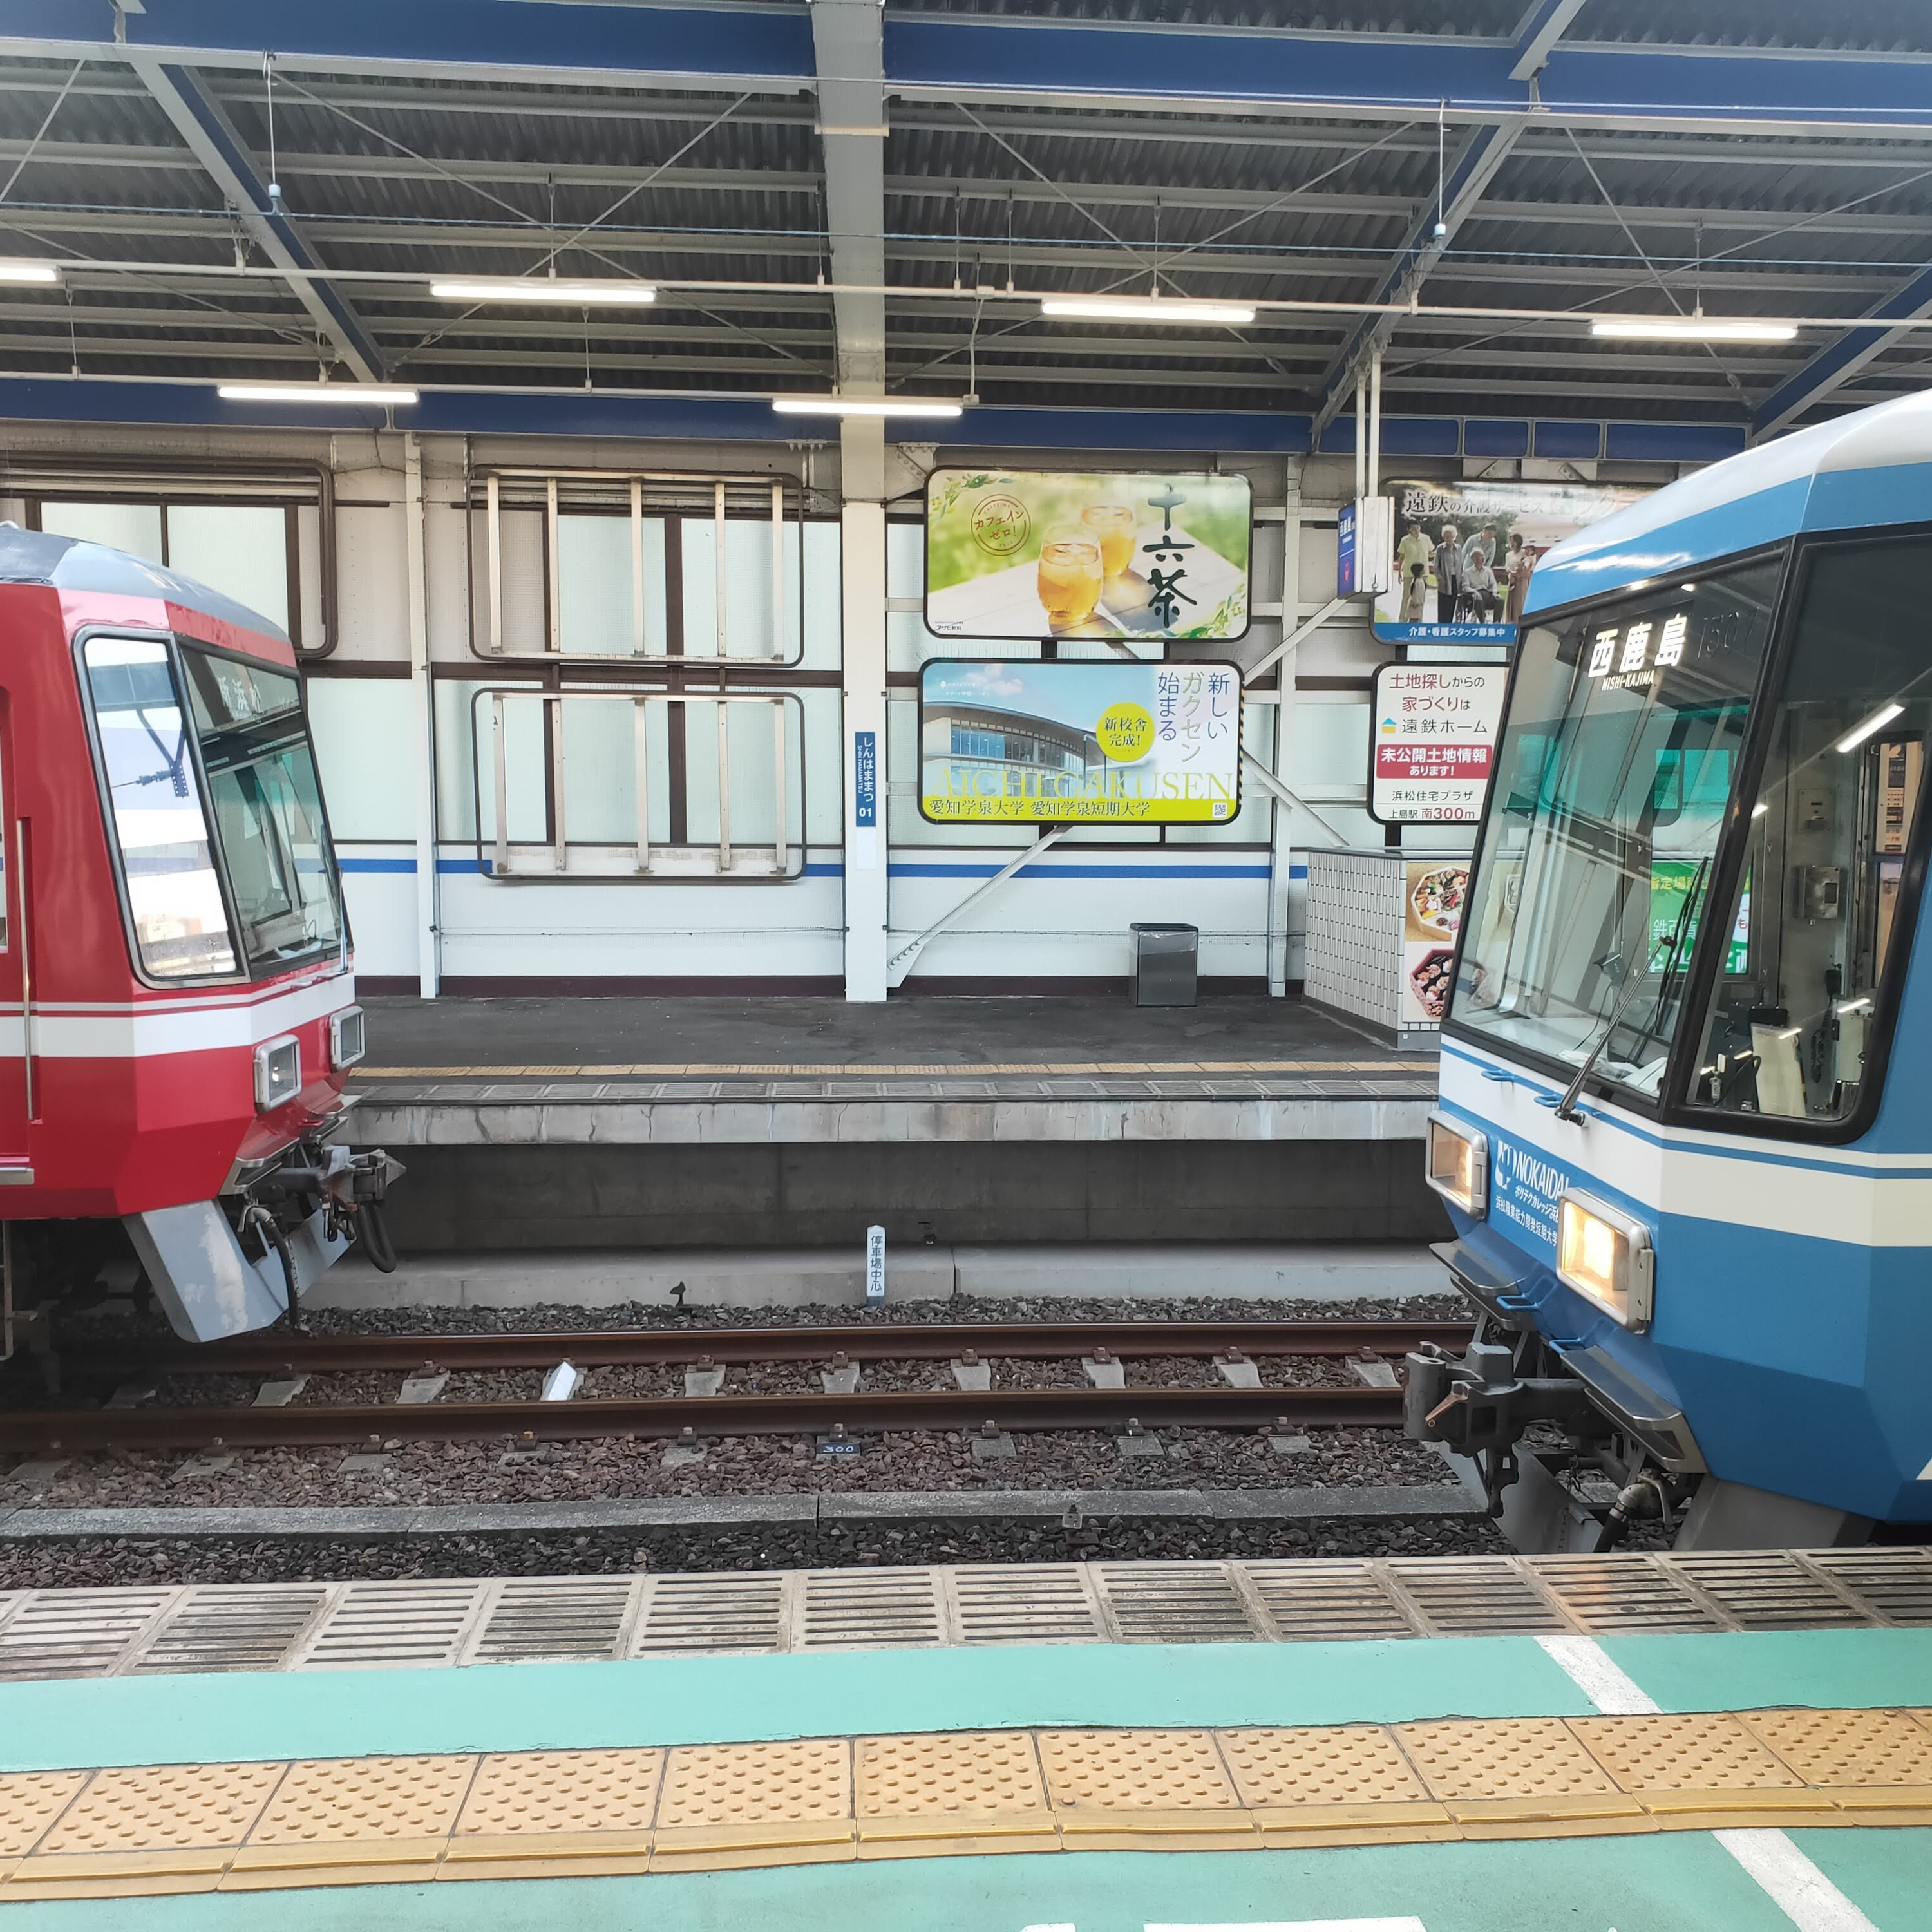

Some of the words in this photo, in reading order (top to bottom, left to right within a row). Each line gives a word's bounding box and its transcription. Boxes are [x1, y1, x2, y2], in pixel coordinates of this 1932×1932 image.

[974, 510, 1024, 531] カフェイン
[1142, 483, 1197, 629] 十六茶
[1588, 612, 1687, 677] 西鹿島
[1389, 673, 1485, 690] 土地探しからの
[1601, 670, 1654, 691] NISHI-KAJIMA
[1158, 672, 1180, 741] 始まる
[1208, 672, 1230, 739] 新しい
[1401, 696, 1471, 712] 家づくりは
[1104, 717, 1148, 732] 新校舎
[1181, 671, 1204, 762] ガクセン
[1402, 719, 1488, 734] 遠鉄ホーム
[1108, 733, 1141, 747] 完成!
[1381, 748, 1487, 764] 未公開土地情報
[863, 737, 874, 802] しんはままつ
[1409, 765, 1455, 777] あります!
[928, 770, 1043, 798] AICHI
[1054, 770, 1233, 799] GAKUSEN
[1392, 790, 1474, 802] 浜松住宅プラザ
[858, 807, 872, 817] 01
[929, 799, 1025, 816] 愛知学泉大学
[1030, 799, 1150, 817] 愛知学泉短期大学
[870, 1235, 882, 1292] 停車場中心
